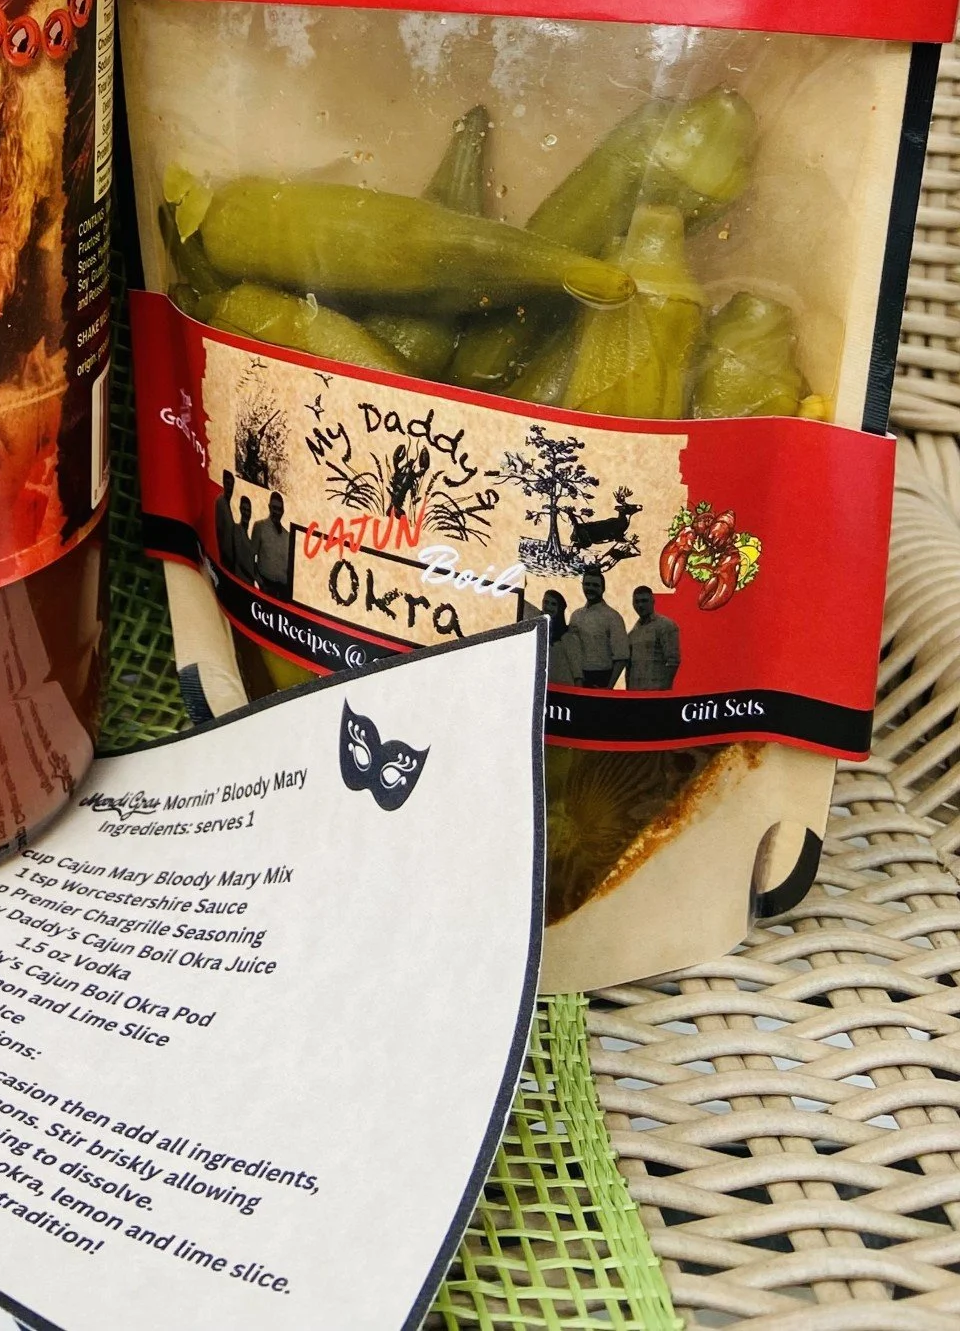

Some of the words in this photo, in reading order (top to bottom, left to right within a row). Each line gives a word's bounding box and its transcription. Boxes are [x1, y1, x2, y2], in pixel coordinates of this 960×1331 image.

[305, 423, 351, 465] My
[304, 495, 428, 559] CAJUN
[418, 546, 526, 597] Boil
[329, 559, 465, 638] Okra
[252, 602, 275, 630] Get
[278, 614, 340, 657] Recipes
[345, 644, 366, 668] @
[681, 700, 718, 722] Gift
[724, 698, 764, 717] Sets
[163, 787, 220, 811] Mornin'
[221, 776, 270, 803] Bloody
[273, 768, 308, 791] Mary
[97, 821, 193, 837] Ingredients:
[194, 816, 244, 834] serves
[245, 810, 255, 828] 1
[15, 868, 30, 878] 1
[29, 872, 58, 888] tsp
[60, 879, 193, 912] Worcestershire
[194, 898, 248, 915] Sauce
[22, 848, 56, 867] cup
[57, 857, 106, 876] Cajun
[107, 867, 154, 886] Mary
[153, 871, 216, 891] Bloody
[217, 870, 262, 890] Mary
[263, 865, 294, 884] Mix
[15, 937, 49, 953] 1.5
[47, 950, 72, 963] oz
[74, 954, 132, 981] Vodka
